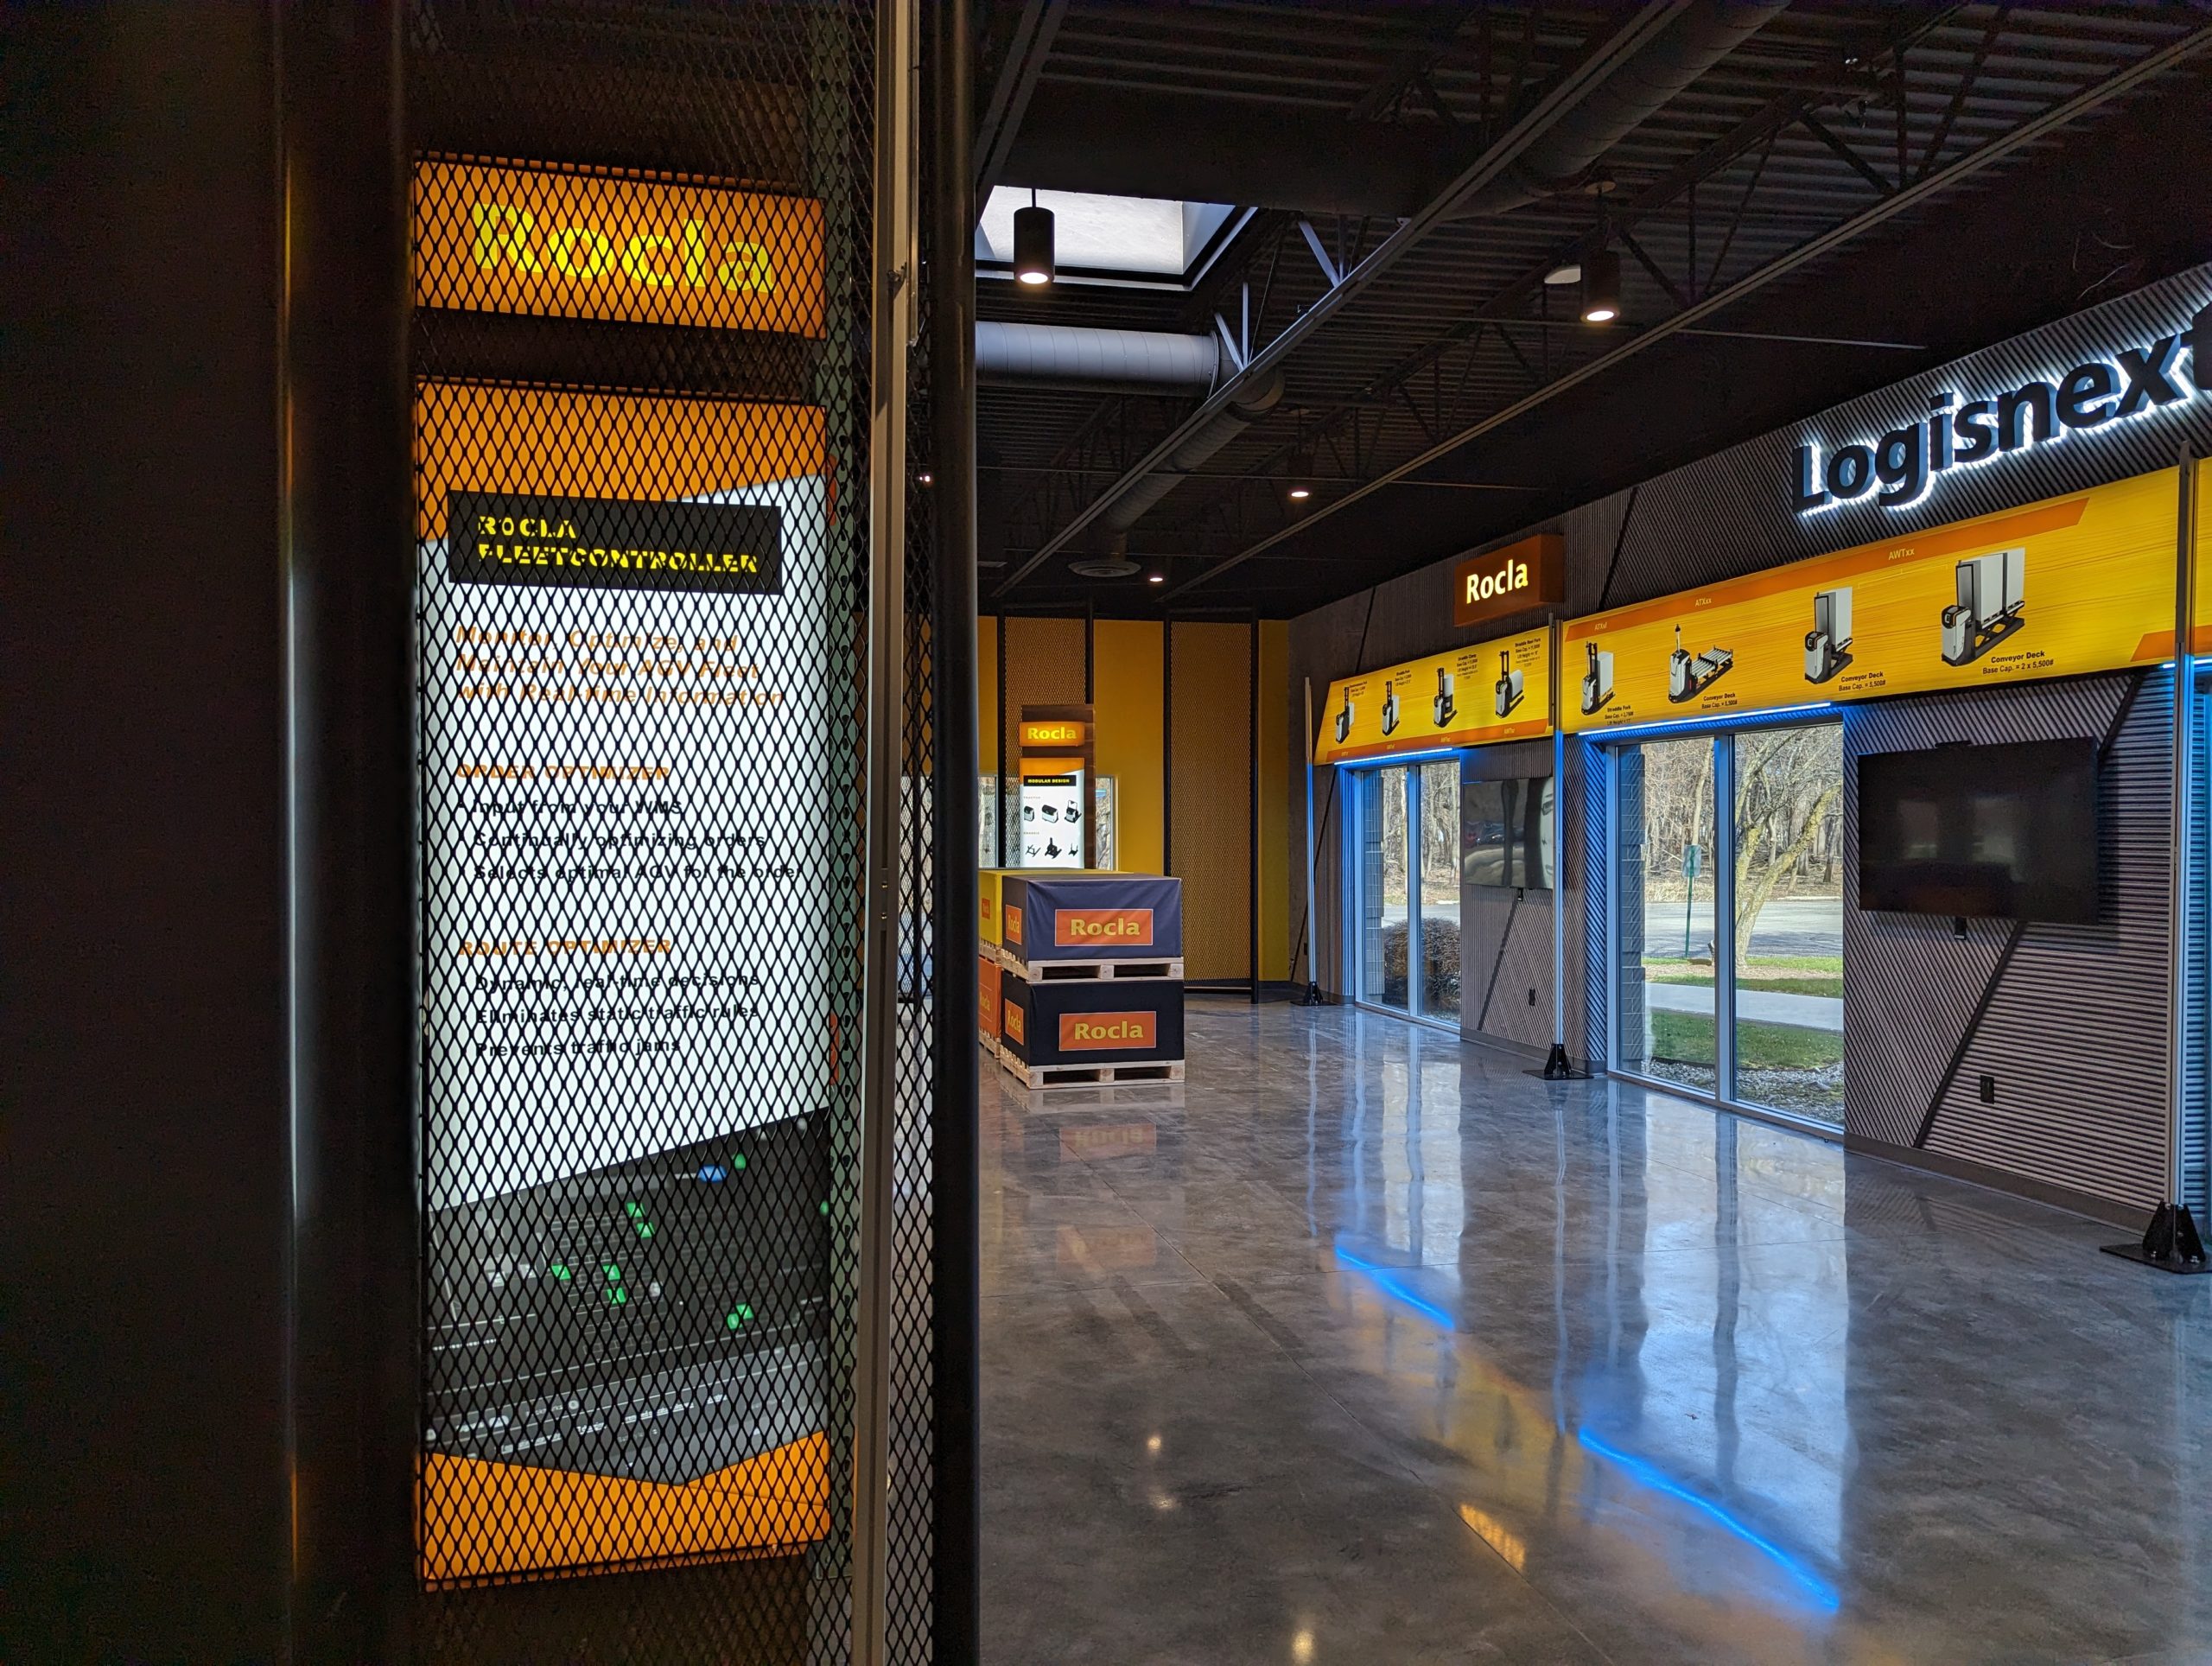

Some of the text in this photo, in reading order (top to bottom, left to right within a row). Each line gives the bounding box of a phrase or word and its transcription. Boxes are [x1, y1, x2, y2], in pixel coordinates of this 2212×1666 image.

[474, 201, 778, 295] Rocla
[478, 516, 577, 539] ROCLA
[478, 543, 758, 574] FLEETCONTROLLER
[1888, 548, 1915, 561] AWTxx
[1466, 558, 1529, 604] Rocla
[695, 634, 739, 652] and
[1991, 650, 2045, 664] Conveyor Deck
[1999, 664, 2014, 673] Cap.
[2032, 659, 2054, 669] 5,500#
[637, 659, 692, 678] AGV
[1840, 674, 1867, 683] Conveyor
[458, 682, 509, 701] with
[1027, 727, 1077, 740] Rocla
[456, 764, 671, 780] ORDER OPTIMIZER
[1071, 918, 1141, 937] Rocla
[459, 939, 672, 956] ROUTE OPTIMIZER
[1073, 1021, 1144, 1040] Rocla
